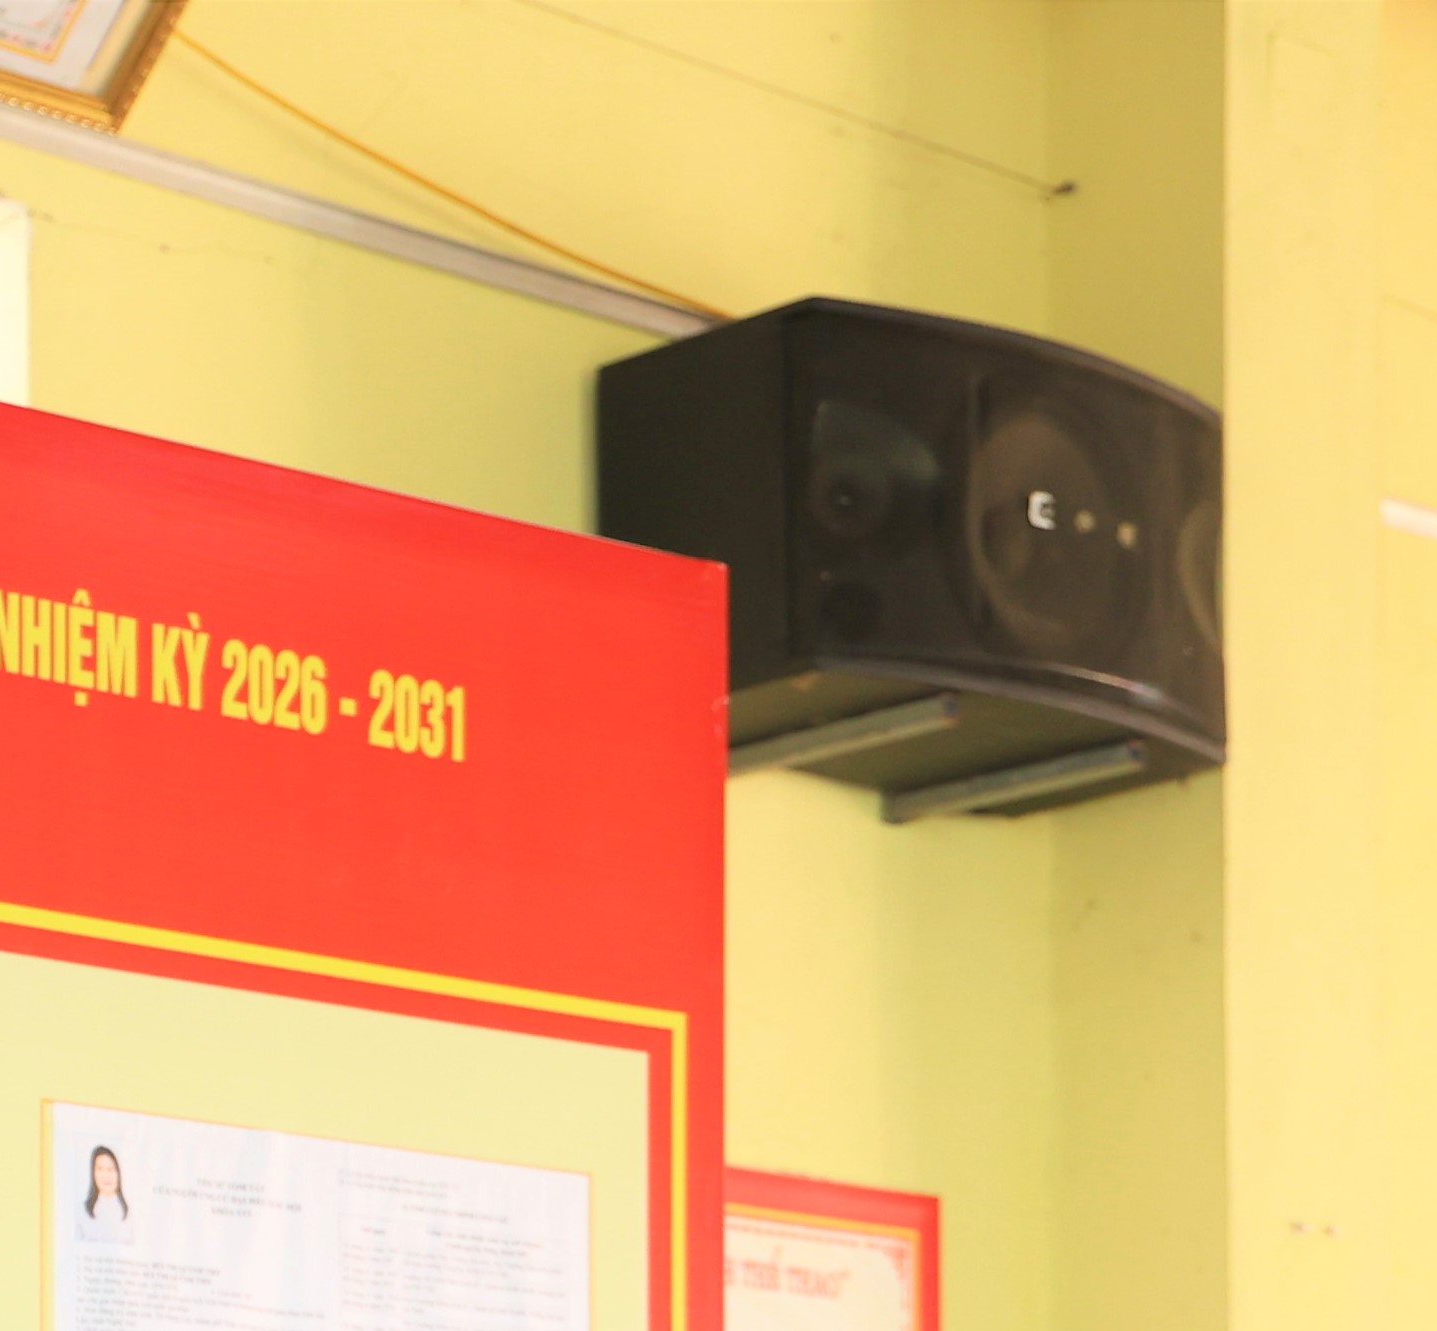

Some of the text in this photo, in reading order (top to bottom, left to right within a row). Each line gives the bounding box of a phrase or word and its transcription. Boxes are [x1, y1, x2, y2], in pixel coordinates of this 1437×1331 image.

[152, 612, 210, 710] KỲ
[221, 639, 328, 734] 2026
[368, 670, 465, 762] 2031
